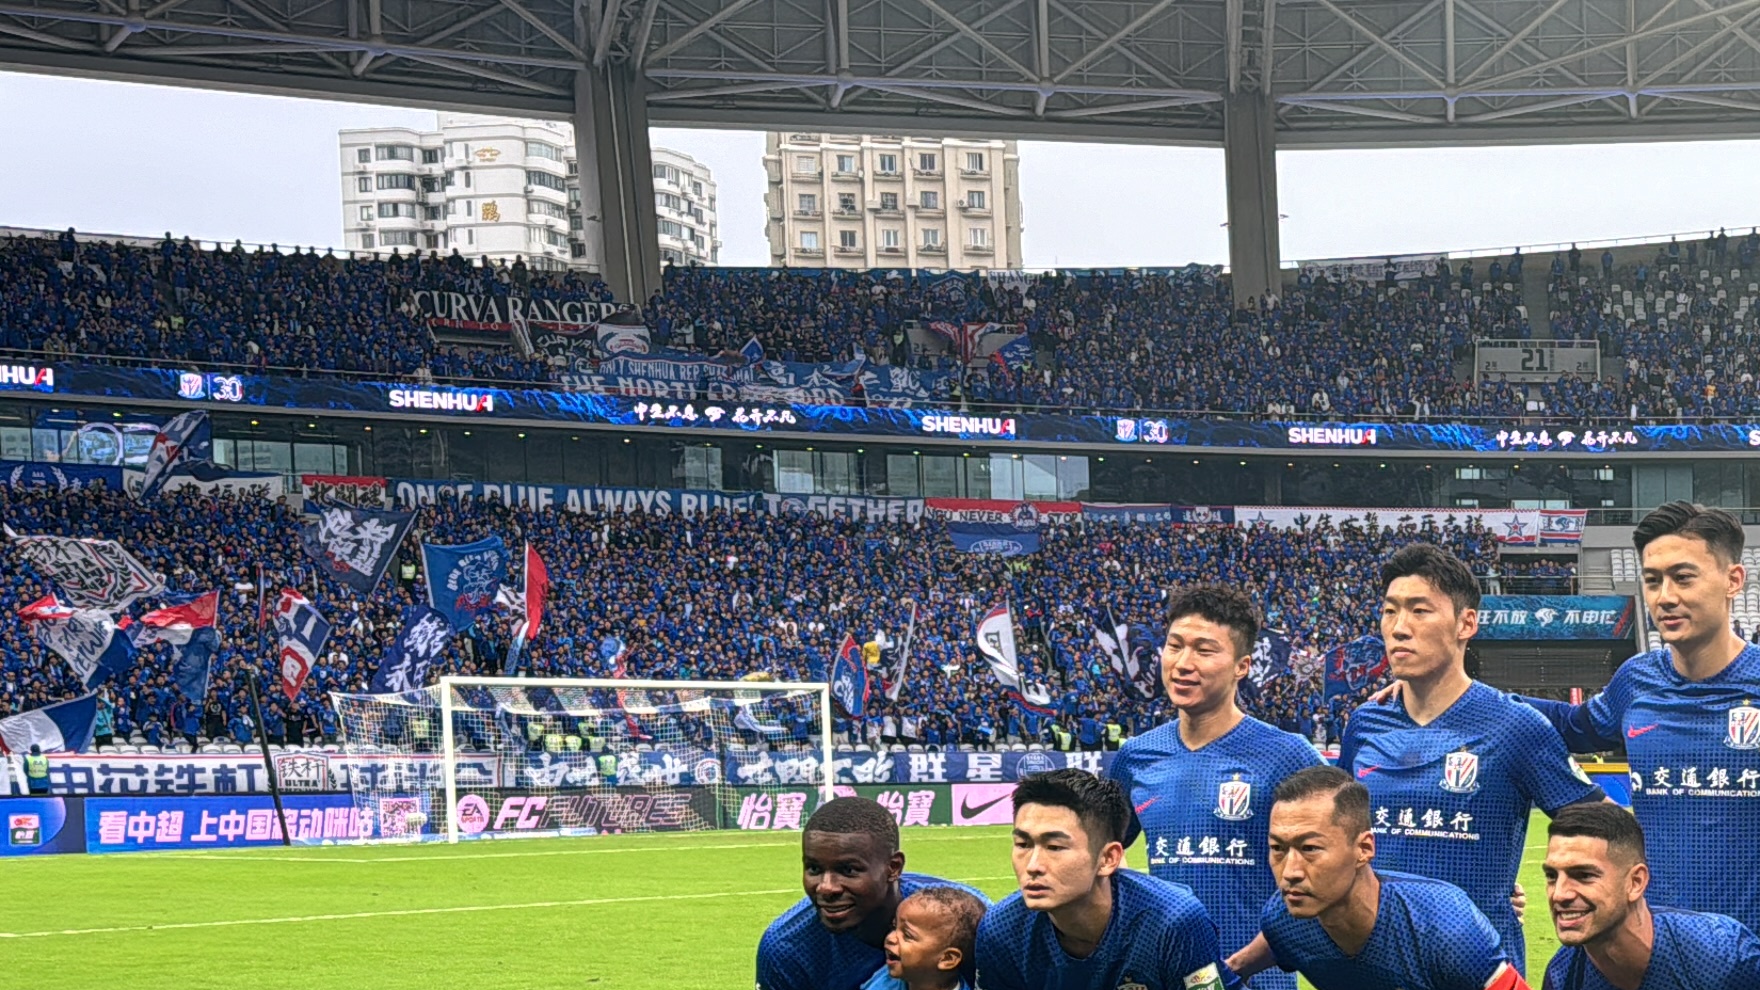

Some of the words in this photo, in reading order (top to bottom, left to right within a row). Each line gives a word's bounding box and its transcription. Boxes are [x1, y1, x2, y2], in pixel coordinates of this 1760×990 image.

[414, 290, 501, 322] CURVA
[1521, 349, 1548, 371] 21
[0, 365, 54, 386] HUA
[390, 390, 494, 411] SHENHUA
[922, 415, 1015, 434] SHENHUA
[1289, 428, 1376, 445] SHENHUA
[958, 510, 1001, 523] NEVER
[281, 757, 326, 782] 铁杆
[909, 752, 1003, 783] 群星
[285, 779, 318, 787] ULTRA
[1646, 787, 1669, 796] BANK
[1672, 788, 1685, 796] OF
[460, 815, 485, 824] SPORTS
[461, 803, 483, 817] EA
[493, 796, 548, 830] FC
[1374, 806, 1474, 832] 交通銀行
[99, 811, 184, 843] 看中超
[190, 805, 374, 842] 上中国移动咪咕
[1391, 827, 1402, 835] OF
[1405, 828, 1480, 841] COMMUNICATIONS
[1155, 836, 1248, 857] 交通銀行
[1182, 857, 1256, 866] COMMUNICATIONS
